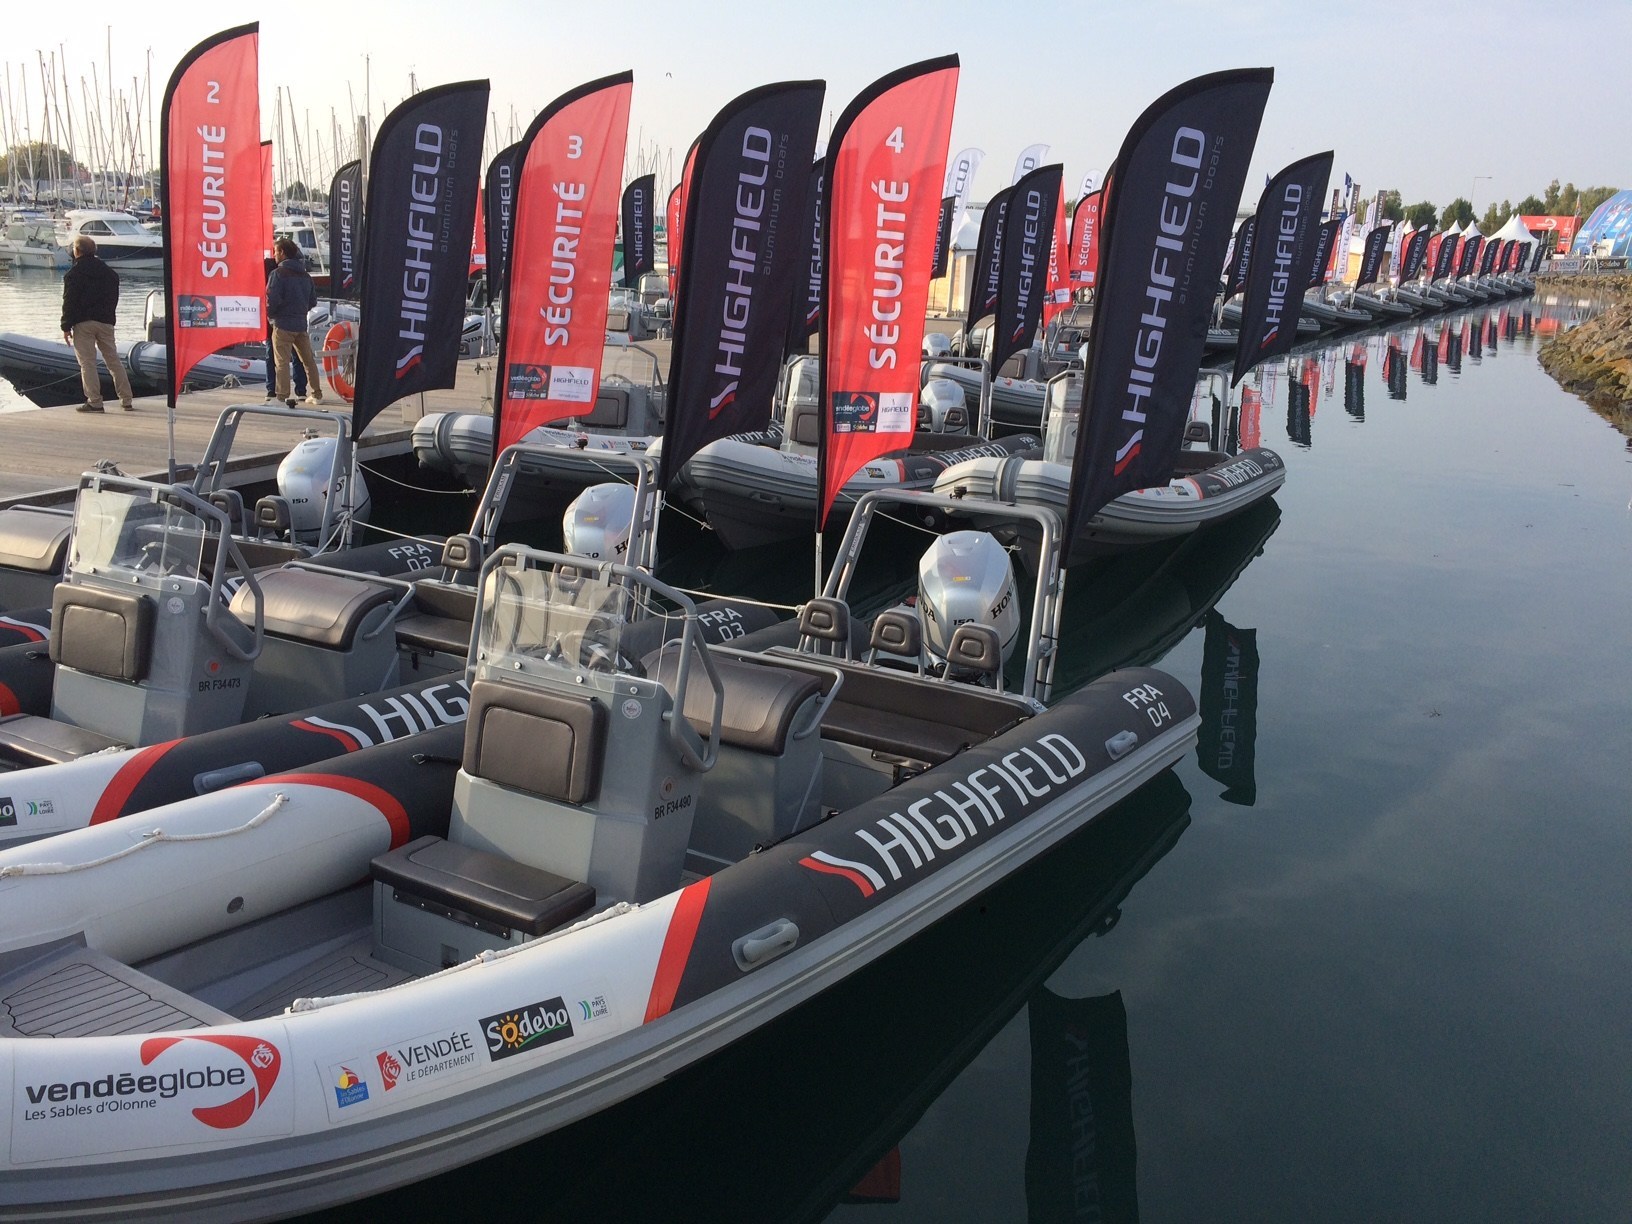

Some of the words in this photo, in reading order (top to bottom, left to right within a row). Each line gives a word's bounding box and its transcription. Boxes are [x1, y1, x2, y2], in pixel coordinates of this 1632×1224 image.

[206, 81, 220, 104] 2
[446, 129, 459, 169] boats
[567, 134, 584, 160] 3
[885, 126, 905, 154] 4
[198, 124, 229, 278] SÉCURITÉ
[439, 176, 456, 253] aluminium
[763, 188, 783, 276] aluminium
[774, 133, 790, 179] boats
[1087, 204, 1097, 213] 10
[1178, 201, 1208, 304] aluminium
[1203, 135, 1225, 189] boats
[340, 179, 352, 273] HIGHFIELD
[400, 122, 443, 341] HIGHFIELD
[634, 189, 643, 257] HIGHFIELD
[1078, 217, 1095, 266] SÉCURITÉ
[544, 181, 586, 346] SÉCURITÉ
[715, 125, 773, 377] HIGHFIELD
[1017, 190, 1041, 320] HIGHFIELD
[1266, 183, 1303, 323] HIGHFIELD
[1312, 229, 1329, 277] HIGHFIELD
[864, 179, 910, 370] SÉCURITÉ
[1122, 126, 1206, 423] HIGHFIELD
[388, 543, 433, 559] FRA
[407, 556, 433, 573] 02
[697, 607, 743, 627] FRA
[718, 621, 746, 642] 03
[199, 680, 211, 692] BR
[212, 677, 242, 690] F34473
[1122, 683, 1164, 711] FRA
[1146, 701, 1173, 728] 04
[654, 806, 666, 820] BR
[666, 795, 692, 814] F34490
[855, 733, 1087, 881] HIGHFIELD
[591, 998, 606, 1007] PAYS
[592, 1008, 609, 1017] LOIRE
[486, 1005, 569, 1052] Sodebo
[398, 1032, 473, 1068] VENDÉE
[406, 1071, 416, 1082] LE
[417, 1052, 475, 1080] DÉPARTEMENT
[25, 1107, 47, 1121] Les
[50, 1104, 93, 1119] Sables
